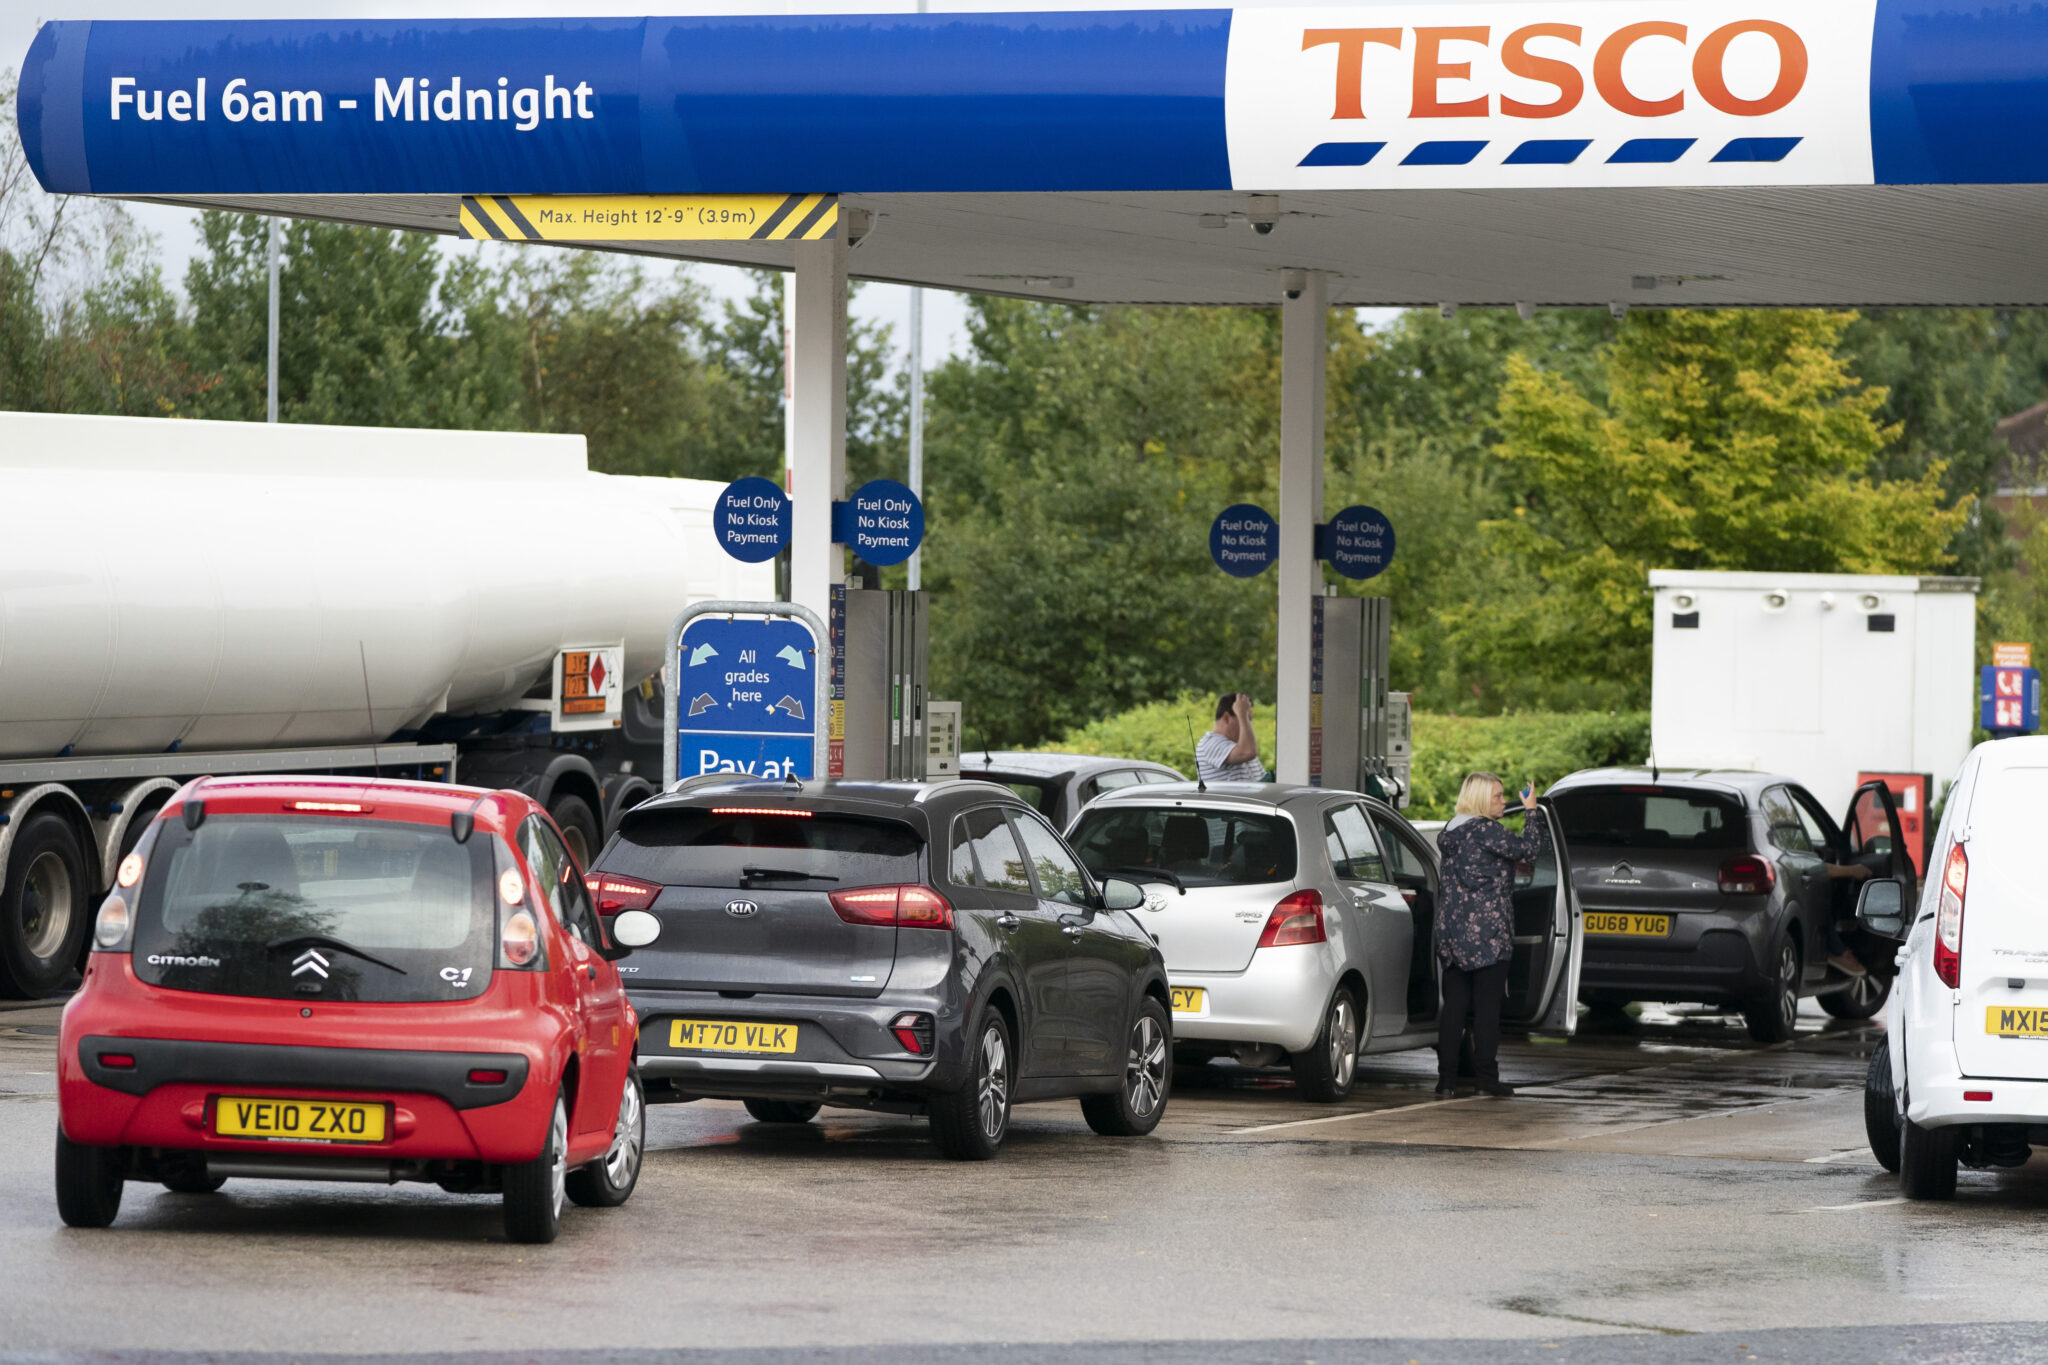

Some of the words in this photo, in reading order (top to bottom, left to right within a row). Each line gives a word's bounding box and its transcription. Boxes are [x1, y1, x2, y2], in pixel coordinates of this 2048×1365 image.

[1301, 19, 1809, 119] TESCO
[110, 77, 206, 122] Fuel
[223, 77, 323, 122] 6am
[339, 99, 357, 110] -
[374, 75, 594, 131] Midnight
[539, 209, 576, 224] Max.
[583, 209, 638, 225] Height
[726, 495, 750, 508] Fuel
[753, 496, 781, 511] Only
[857, 498, 881, 511] Fuel
[884, 499, 912, 514] Only
[727, 513, 744, 525] No
[747, 513, 779, 526] Kiosk
[858, 515, 875, 528] No
[877, 516, 910, 529] Kiosk
[1220, 519, 1242, 531] Fuel
[1244, 520, 1269, 533] Only
[1336, 520, 1358, 532] Fuel
[1360, 522, 1385, 536] Only
[727, 530, 778, 545] Payment
[857, 533, 910, 548] Payment
[1221, 534, 1237, 546] No
[1238, 535, 1267, 546] Kiosk
[1336, 535, 1352, 546] No
[1354, 537, 1383, 548] Kiosk
[1221, 549, 1266, 562] Payment
[1335, 551, 1382, 564] Payment
[738, 650, 756, 664] All
[725, 669, 770, 685] grades
[732, 687, 762, 702] here
[761, 756, 795, 779] at
[730, 902, 752, 914] KIA
[1585, 915, 1628, 931] GU68
[1634, 917, 1666, 933] YUG
[147, 954, 221, 967] CITROËN
[439, 966, 473, 981] C1
[2000, 1009, 2048, 1032] MX15
[679, 1023, 738, 1045] MT70
[746, 1026, 788, 1048] VLK
[237, 1103, 299, 1131] VE10
[309, 1106, 365, 1134] ZXO
